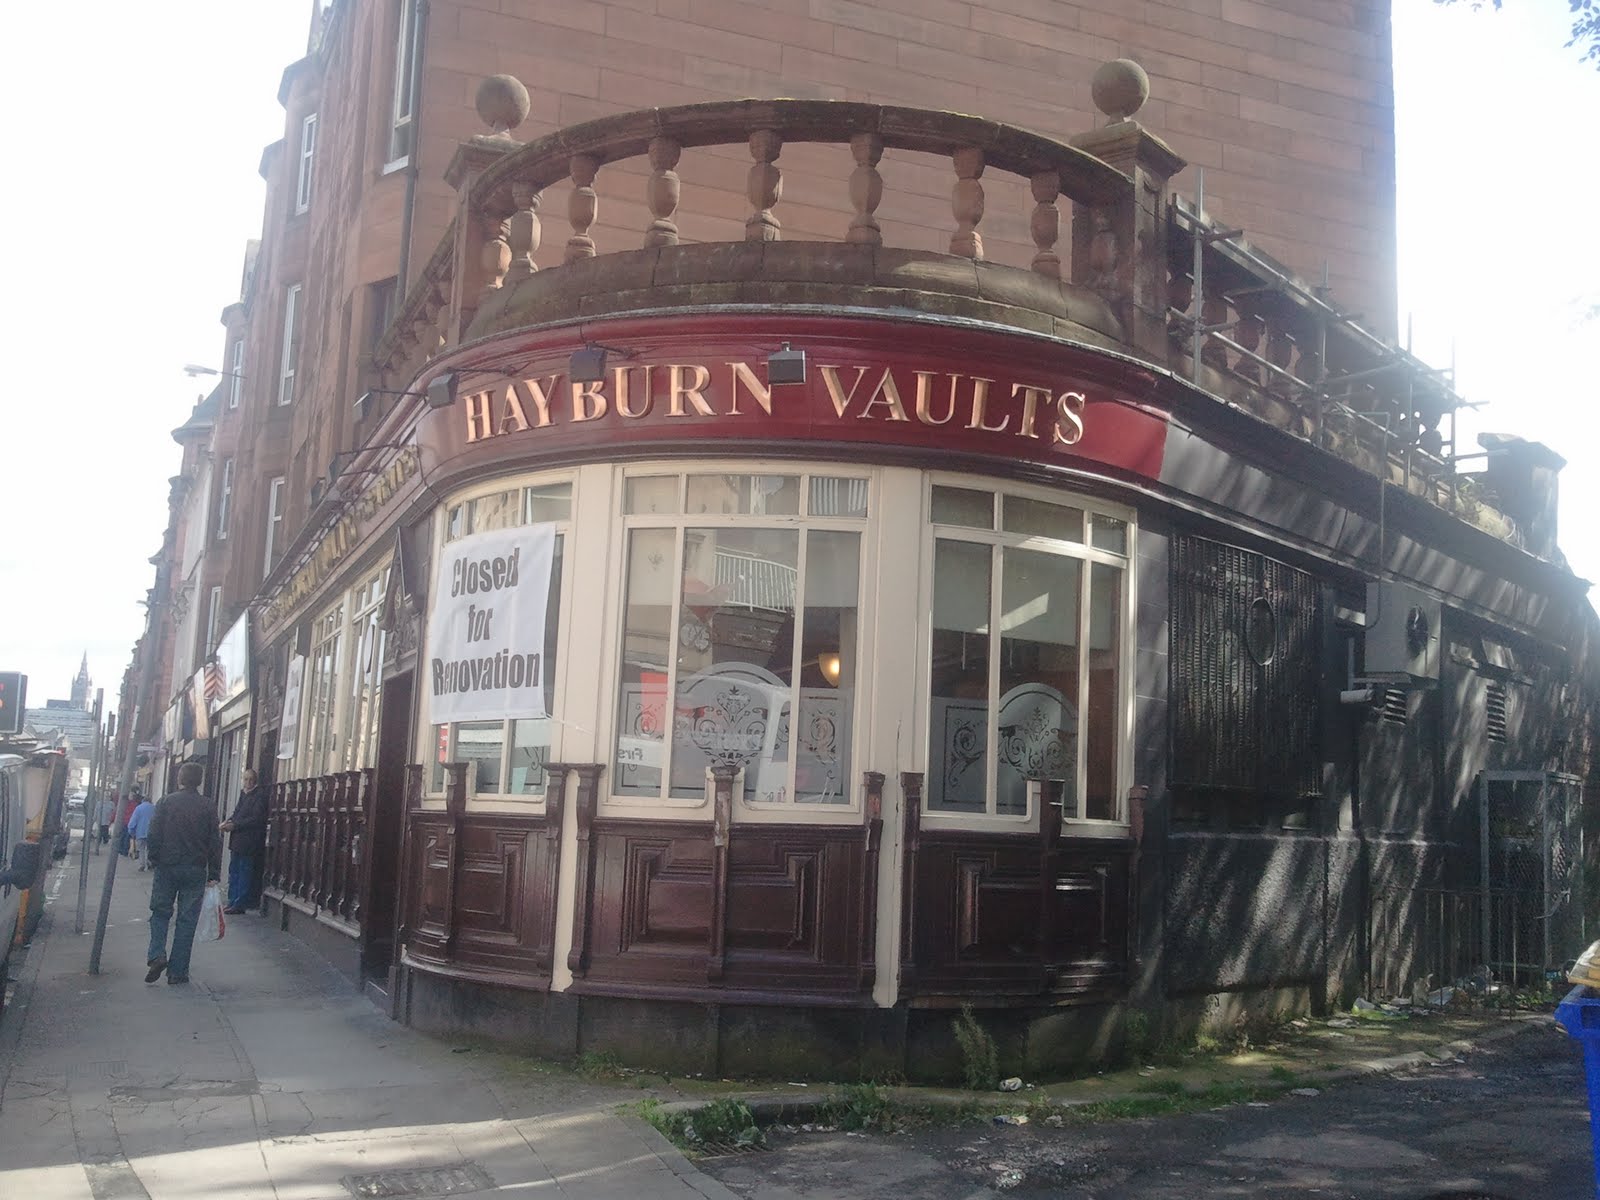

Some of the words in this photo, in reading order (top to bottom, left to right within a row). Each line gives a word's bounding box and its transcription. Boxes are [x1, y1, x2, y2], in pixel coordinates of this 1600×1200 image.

[463, 361, 774, 443] HAYBURN
[815, 363, 1086, 445] VAULTS
[451, 547, 520, 598] Closed
[467, 604, 494, 643] for
[432, 648, 541, 696] Renovation
